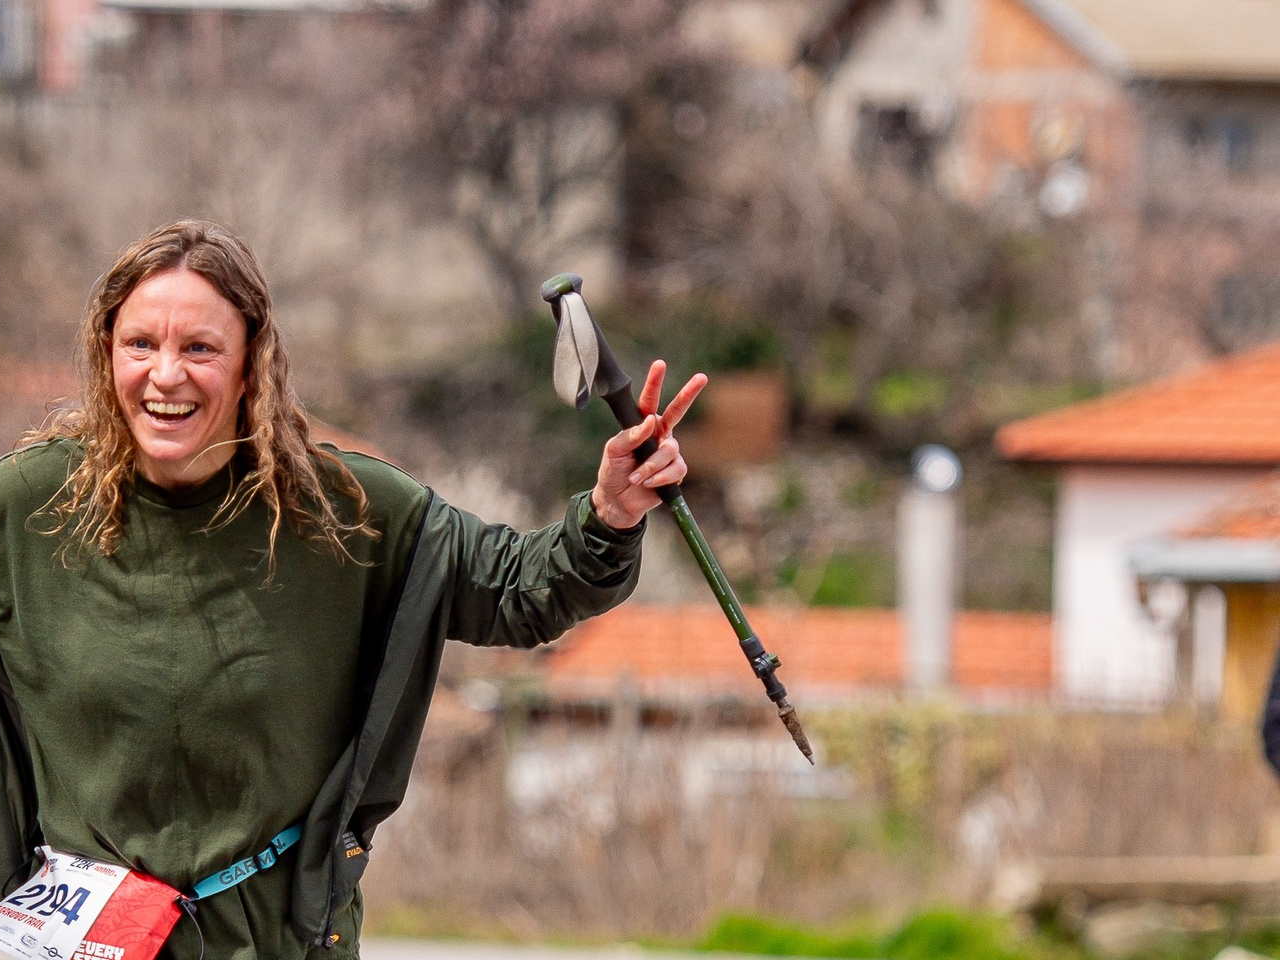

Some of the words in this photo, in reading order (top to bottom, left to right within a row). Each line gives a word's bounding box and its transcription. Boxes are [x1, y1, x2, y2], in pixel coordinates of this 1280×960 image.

[5, 883, 91, 926] 2194
[24, 915, 47, 931] TRAIL
[76, 940, 125, 960] EVERY
